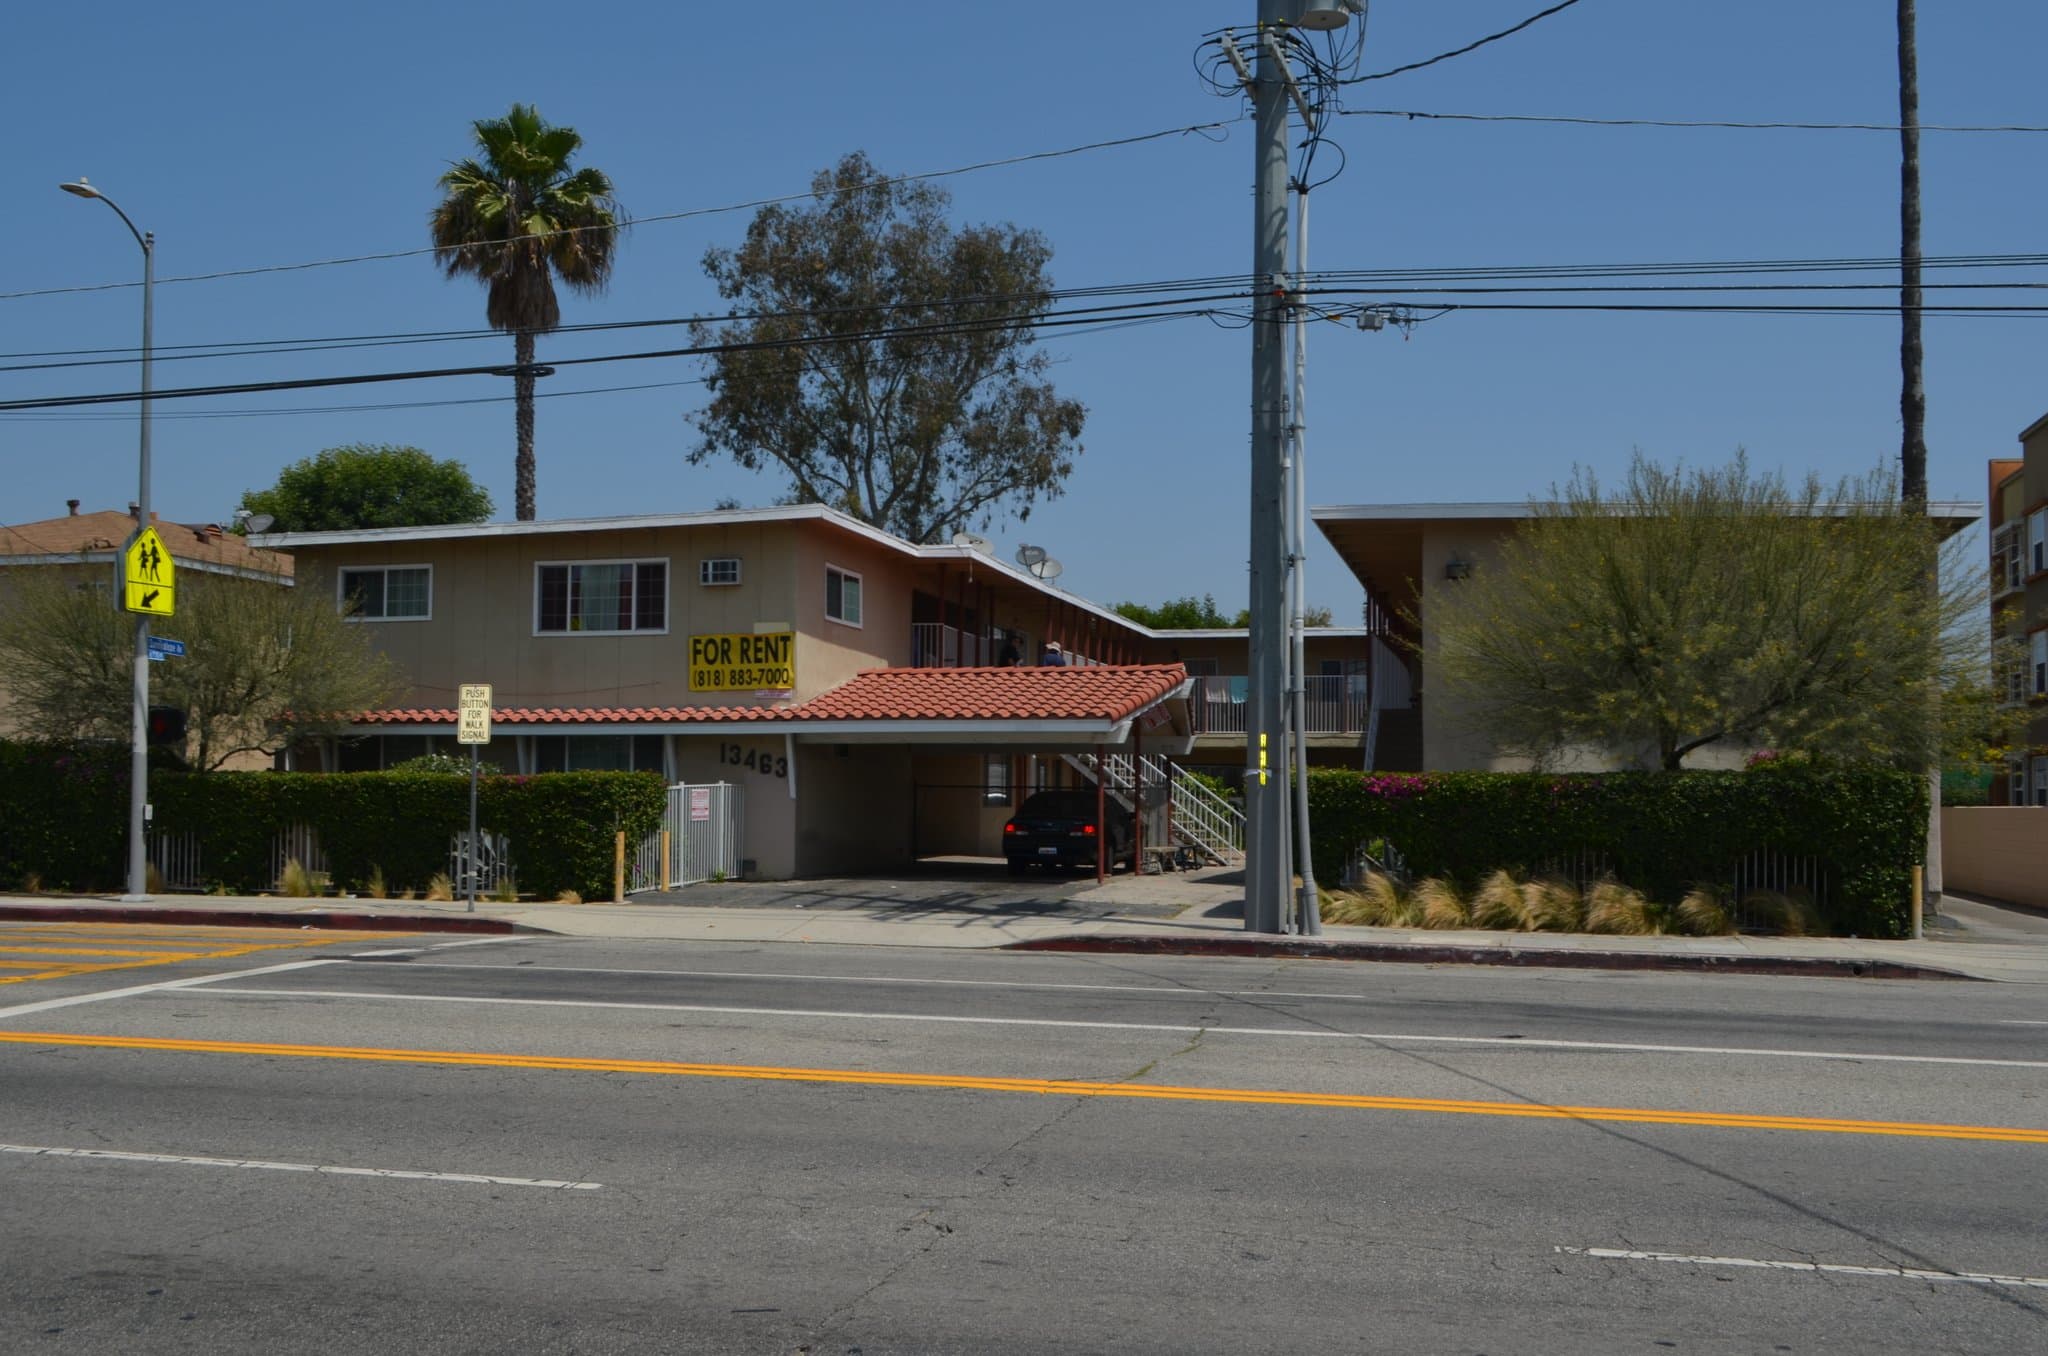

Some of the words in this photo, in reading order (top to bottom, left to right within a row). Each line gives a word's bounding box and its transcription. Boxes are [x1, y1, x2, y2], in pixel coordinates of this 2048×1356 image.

[692, 638, 732, 665] FOR
[740, 635, 791, 665] RENT
[693, 669, 725, 688] (818)
[729, 668, 790, 686] 883-7000
[465, 689, 485, 698] PUSH
[461, 700, 489, 709] BUTTON
[468, 710, 482, 719] FOR
[465, 720, 483, 729] WALK
[461, 730, 486, 740] SIGNAL
[720, 743, 788, 778] 13463
